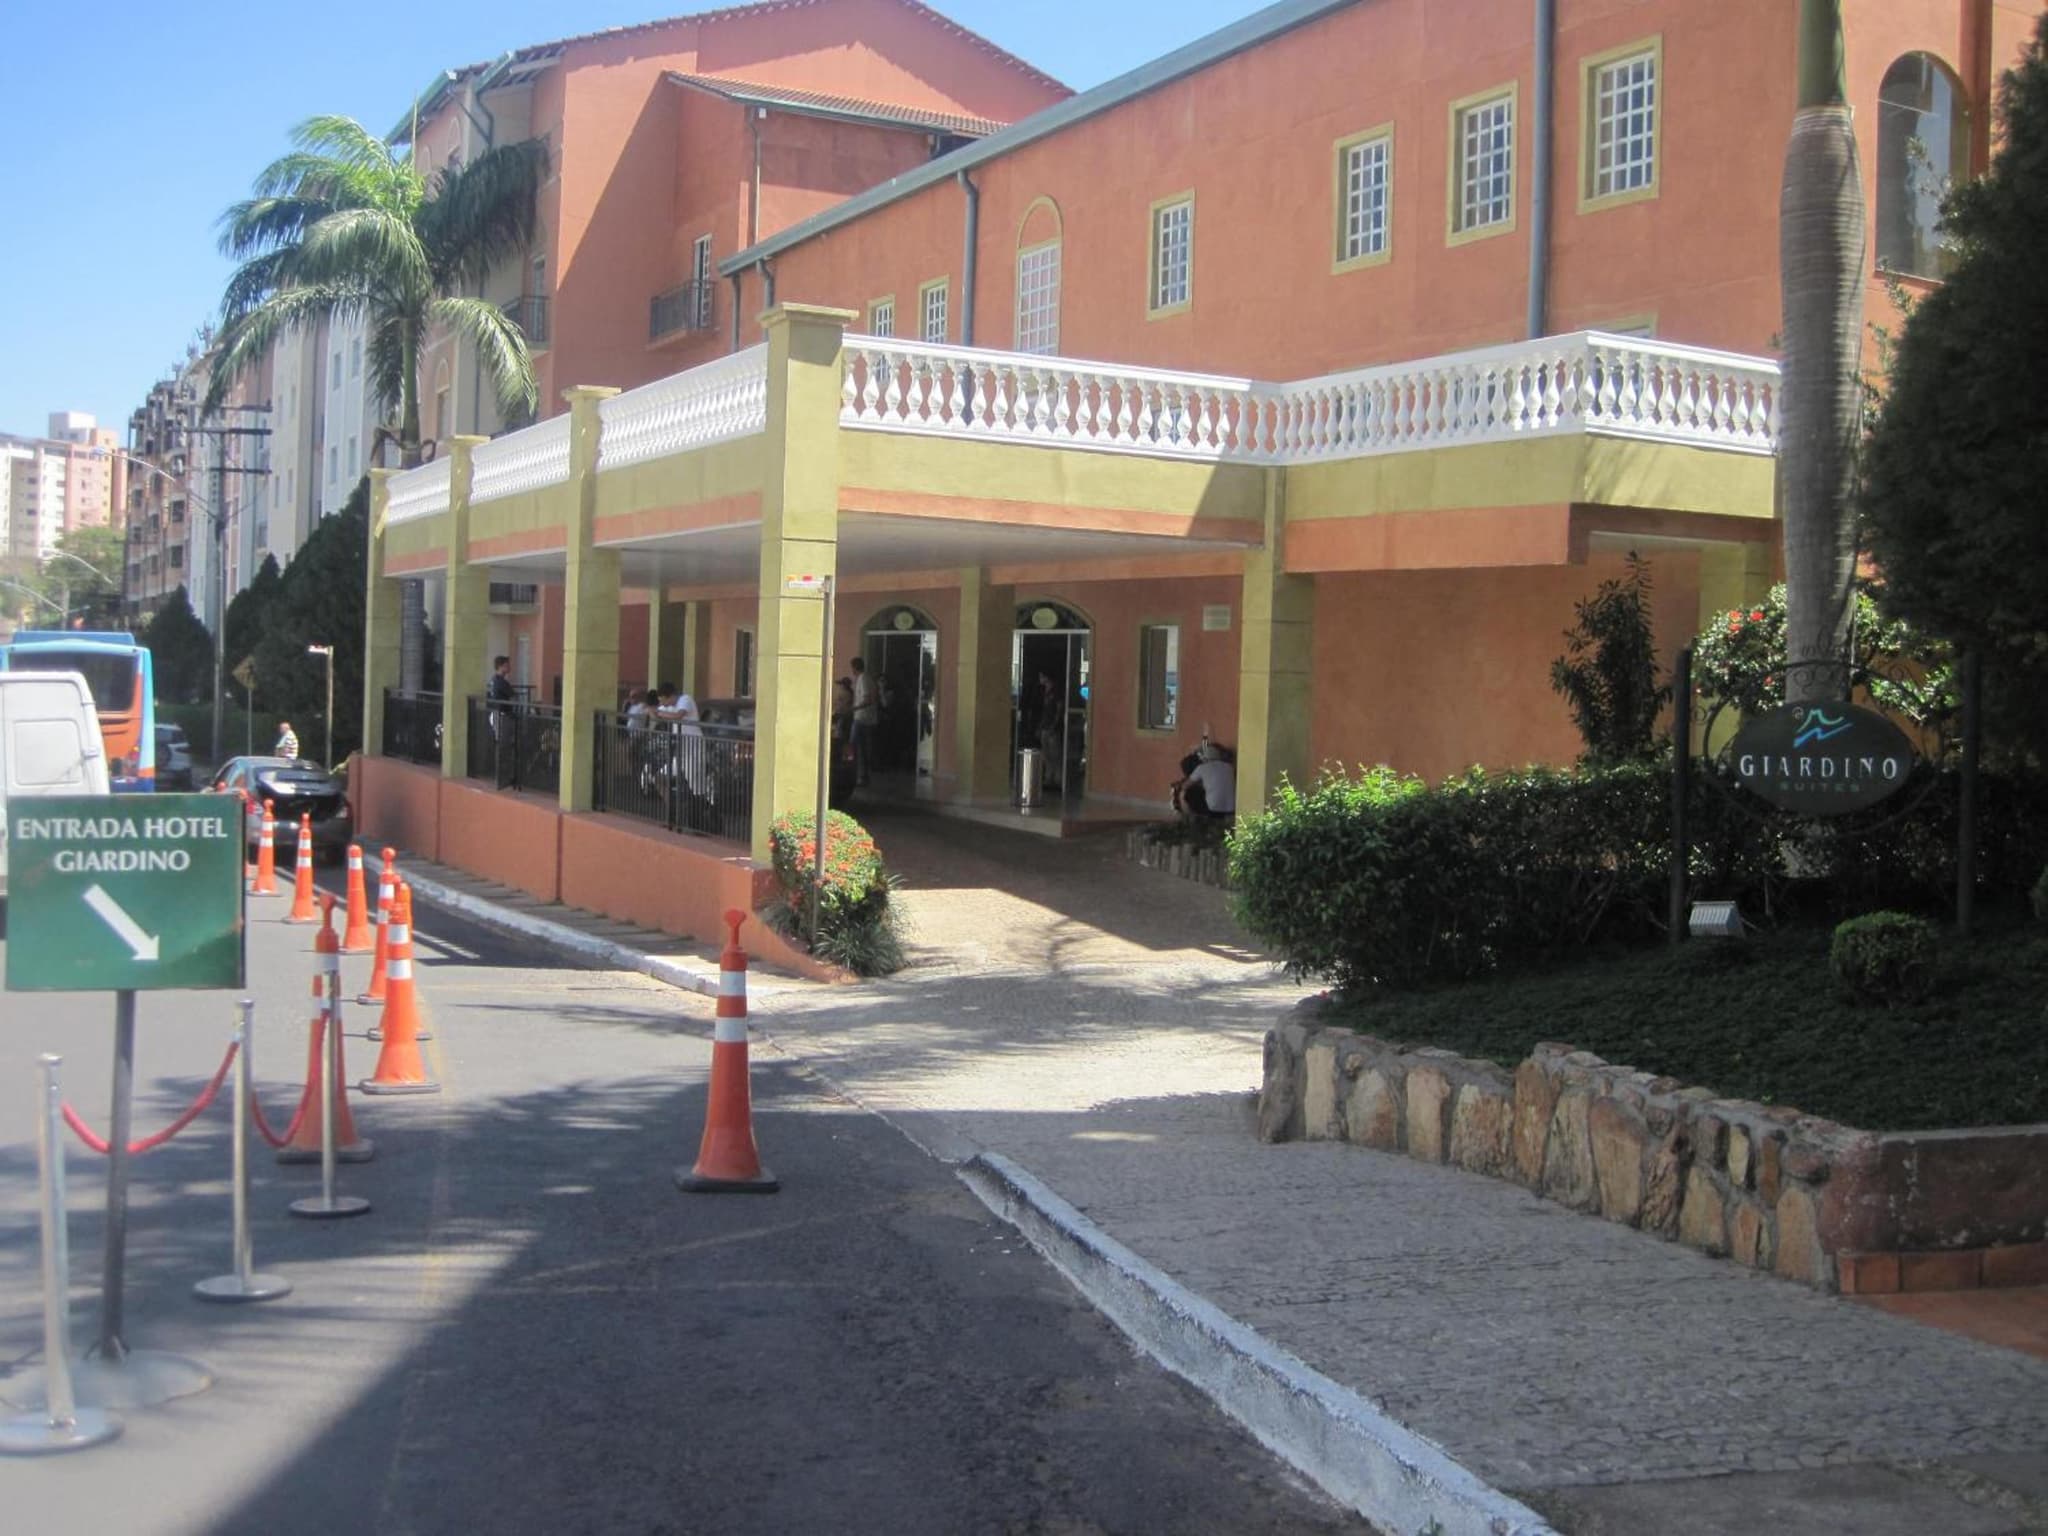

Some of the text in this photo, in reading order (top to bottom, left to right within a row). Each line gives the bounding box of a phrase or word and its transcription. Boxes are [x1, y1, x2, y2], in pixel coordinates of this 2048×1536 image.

[1740, 755, 1898, 779] GIARDINO
[17, 817, 228, 839] ENTRADA HOTEL
[54, 850, 190, 871] GIARDINO
